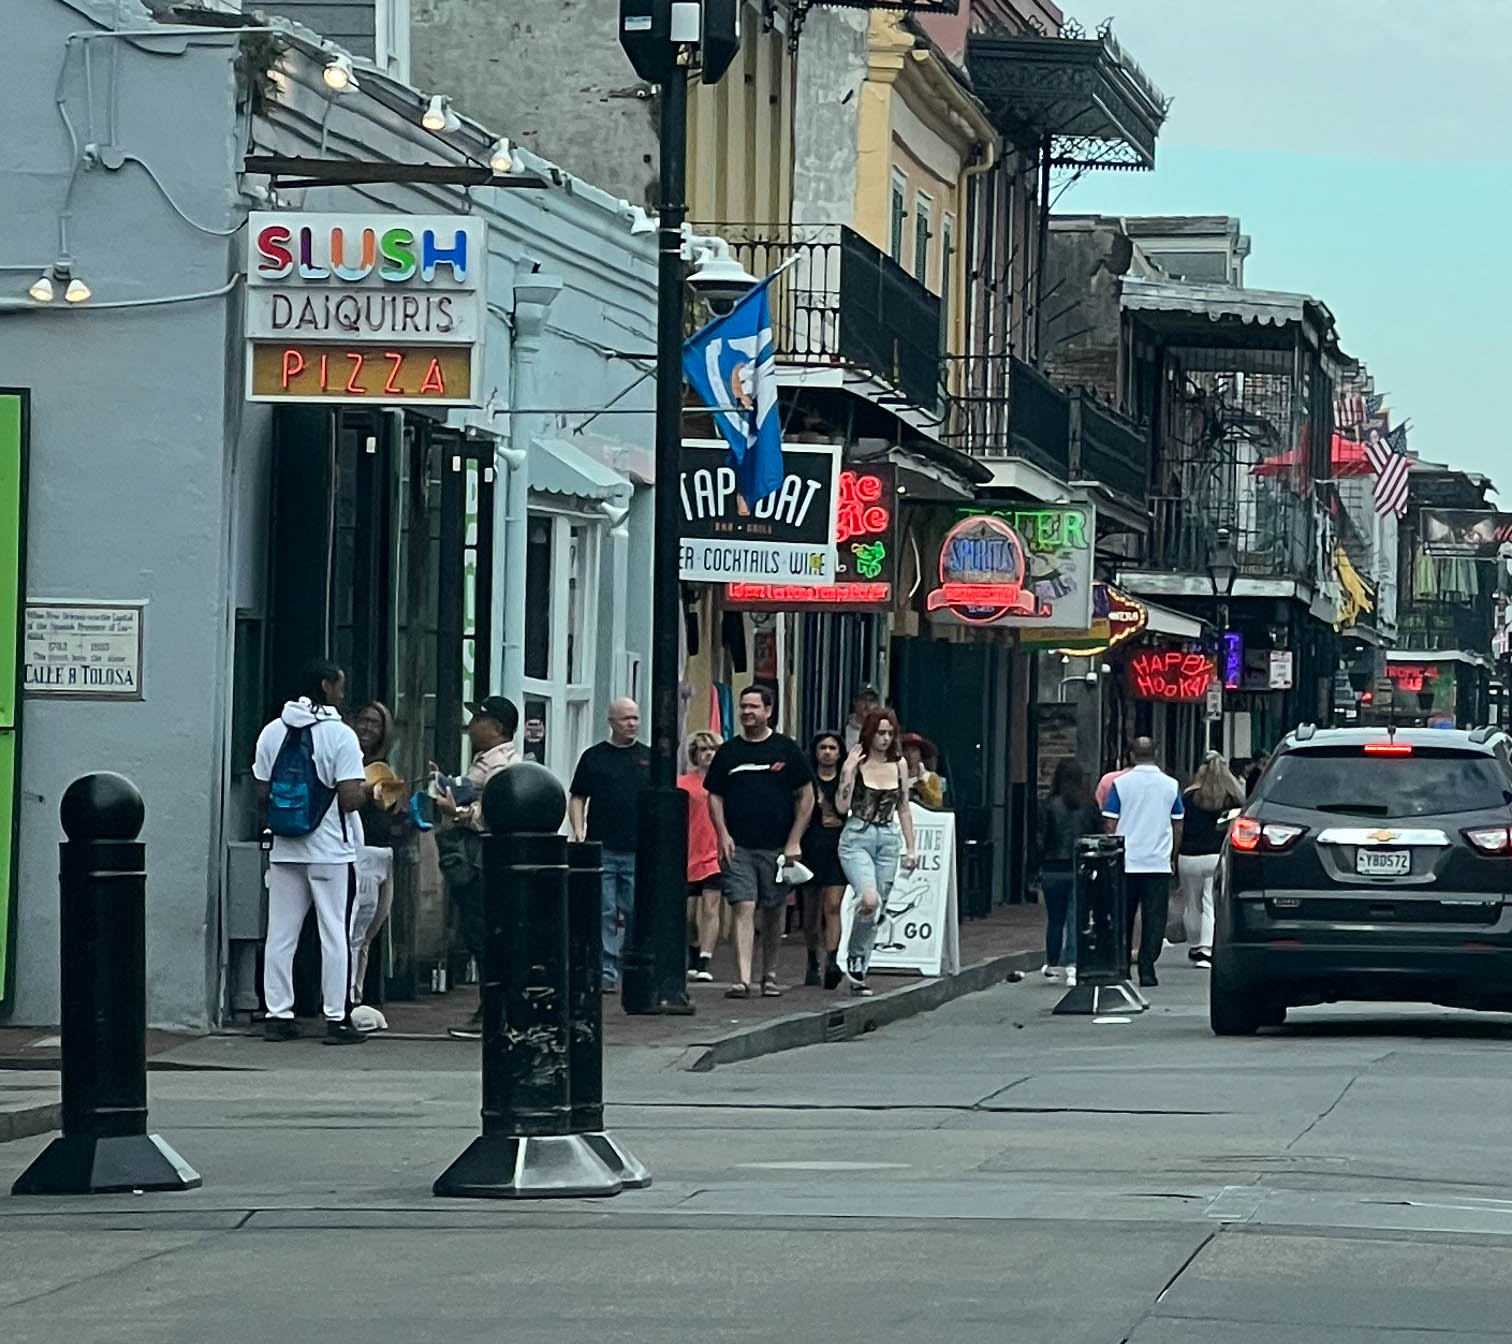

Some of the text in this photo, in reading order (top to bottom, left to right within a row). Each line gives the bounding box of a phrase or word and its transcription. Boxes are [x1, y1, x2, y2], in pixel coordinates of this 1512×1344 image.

[257, 225, 468, 283] SLUSH
[272, 293, 455, 333] DAIQUIRIS
[282, 349, 444, 394] PIZZA
[704, 548, 780, 574] COCKTAILS
[950, 537, 1017, 573] SPIRITS
[24, 664, 64, 685] CALLE
[81, 665, 134, 686] TOLOSA
[1132, 652, 1214, 676] HAPPY
[904, 922, 933, 940] GO
